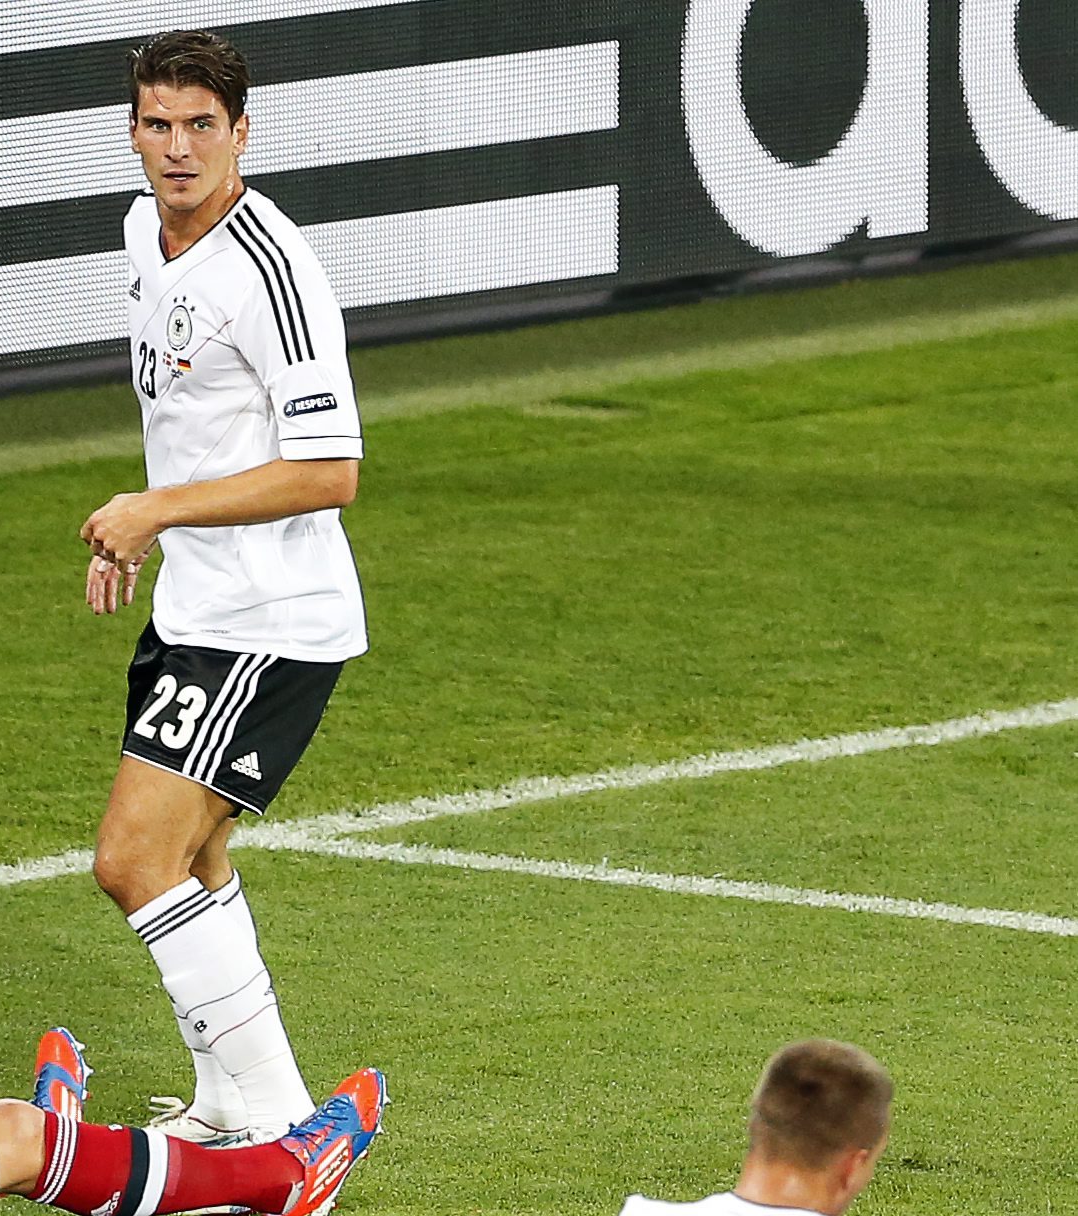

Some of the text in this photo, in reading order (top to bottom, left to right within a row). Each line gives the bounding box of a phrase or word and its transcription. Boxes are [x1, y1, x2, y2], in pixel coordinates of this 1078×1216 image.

[139, 341, 157, 400] 23
[295, 395, 335, 411] RESPECT
[133, 674, 208, 750] 23
[231, 761, 262, 780] adidas
